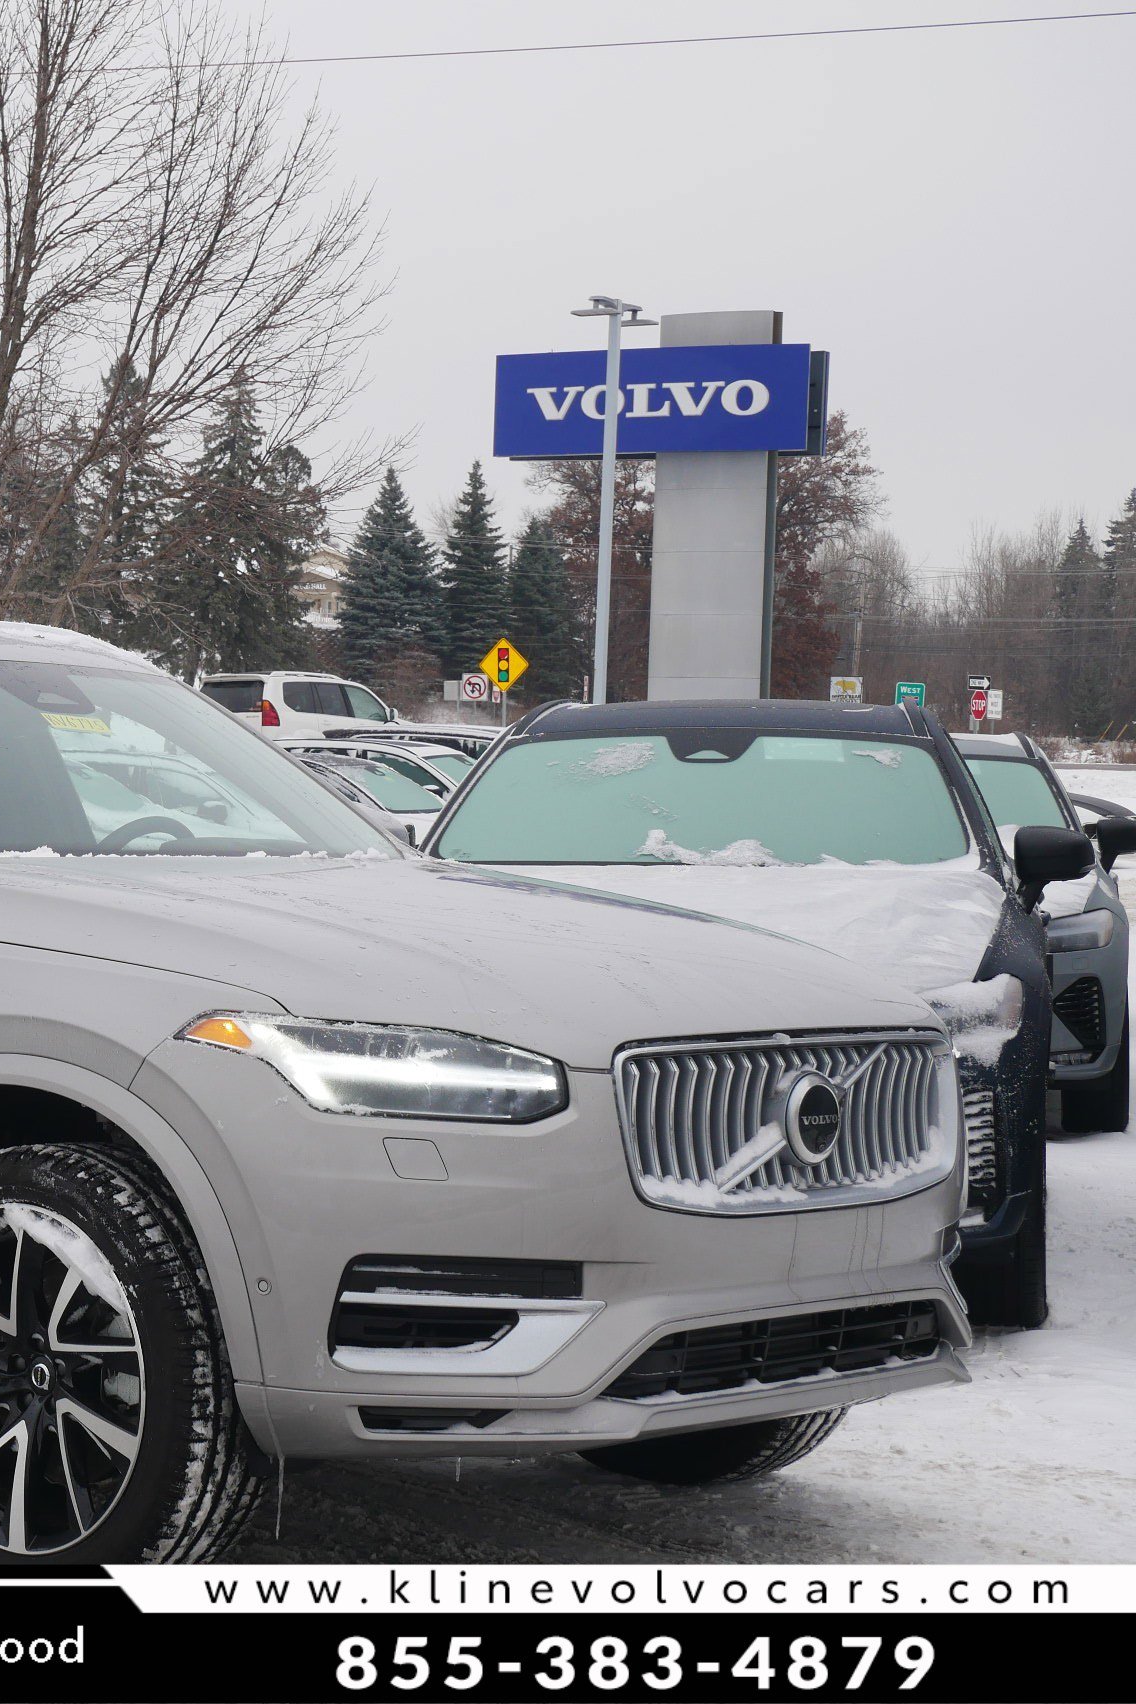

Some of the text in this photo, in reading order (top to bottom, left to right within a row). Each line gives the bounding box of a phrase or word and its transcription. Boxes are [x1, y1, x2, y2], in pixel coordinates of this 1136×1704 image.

[526, 379, 770, 421] VOLVO
[900, 686, 921, 694] WEST
[972, 699, 986, 711] STOP
[801, 1114, 838, 1126] VOLVO
